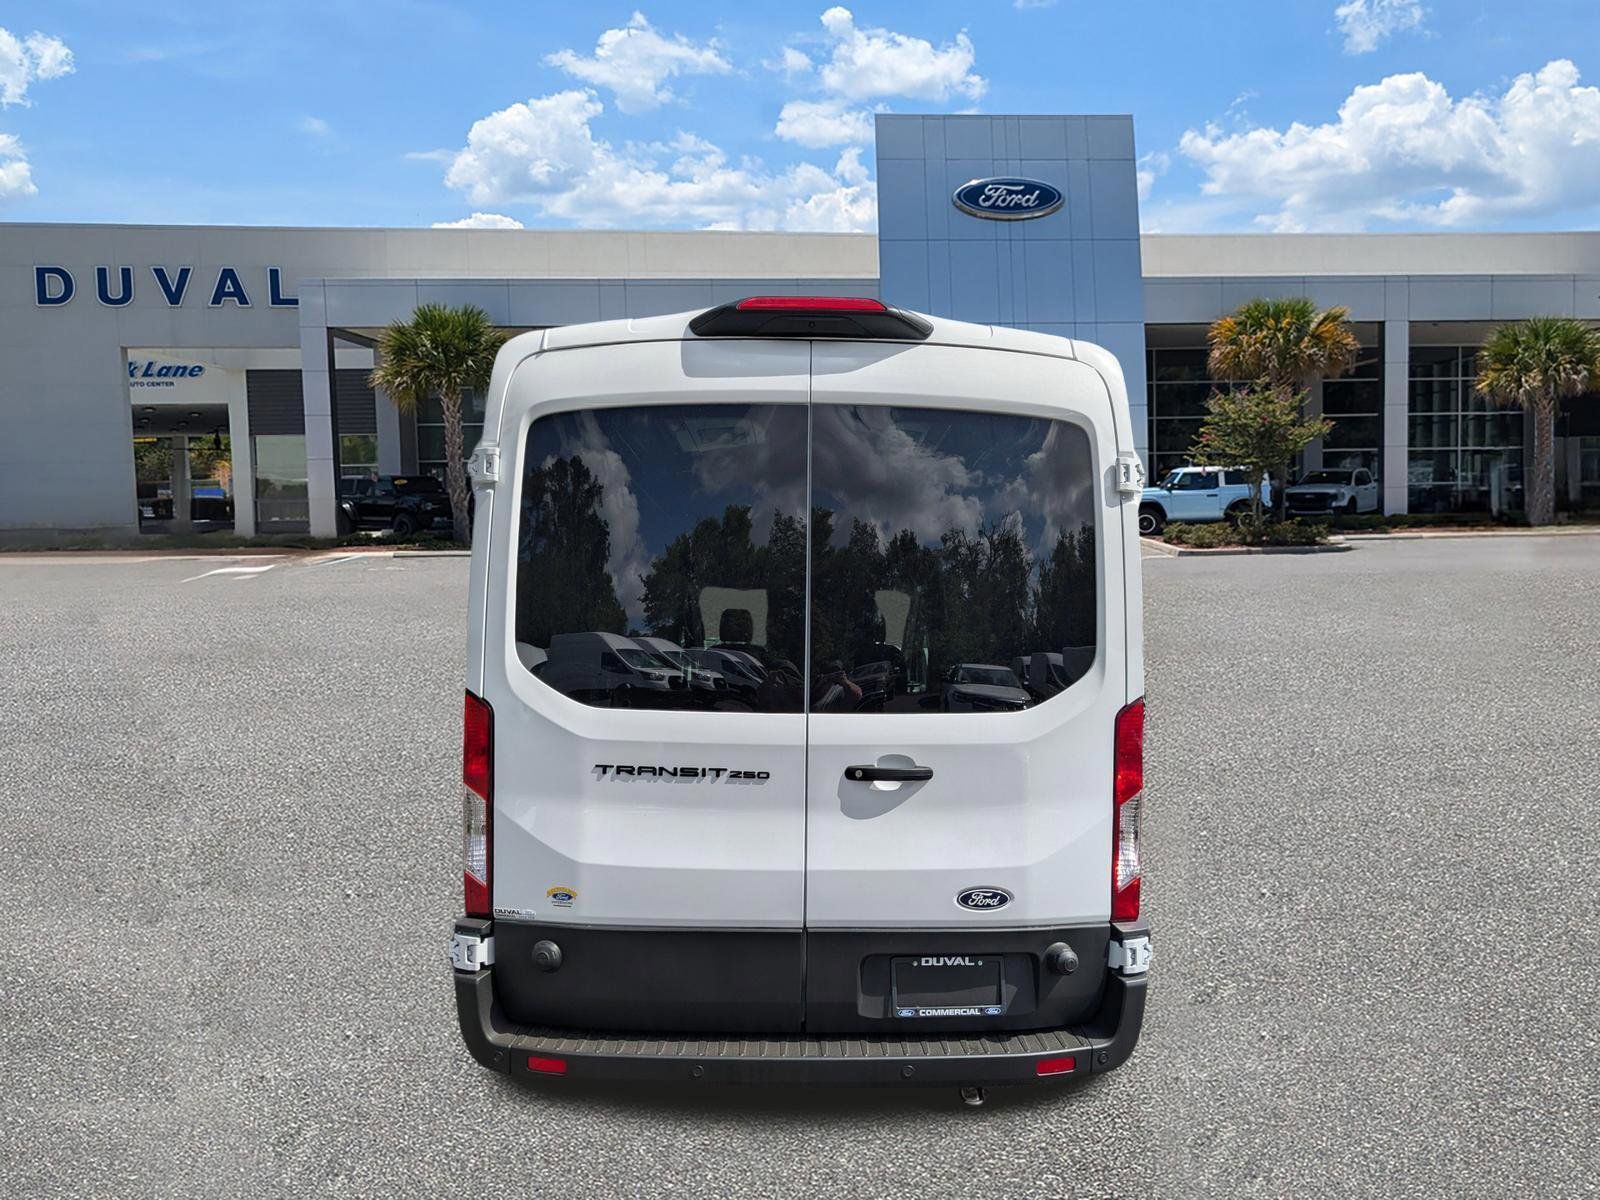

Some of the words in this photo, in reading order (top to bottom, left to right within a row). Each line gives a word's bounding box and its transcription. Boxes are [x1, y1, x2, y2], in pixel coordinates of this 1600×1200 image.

[978, 184, 1040, 207] Ford
[33, 265, 299, 308] DUVAL
[142, 361, 204, 378] Lane
[594, 764, 728, 778] TRANSIT
[729, 770, 770, 779] 250
[967, 891, 1001, 906] Ford
[921, 957, 975, 966] DUVAL
[919, 1008, 981, 1016] COMMERCIAL
